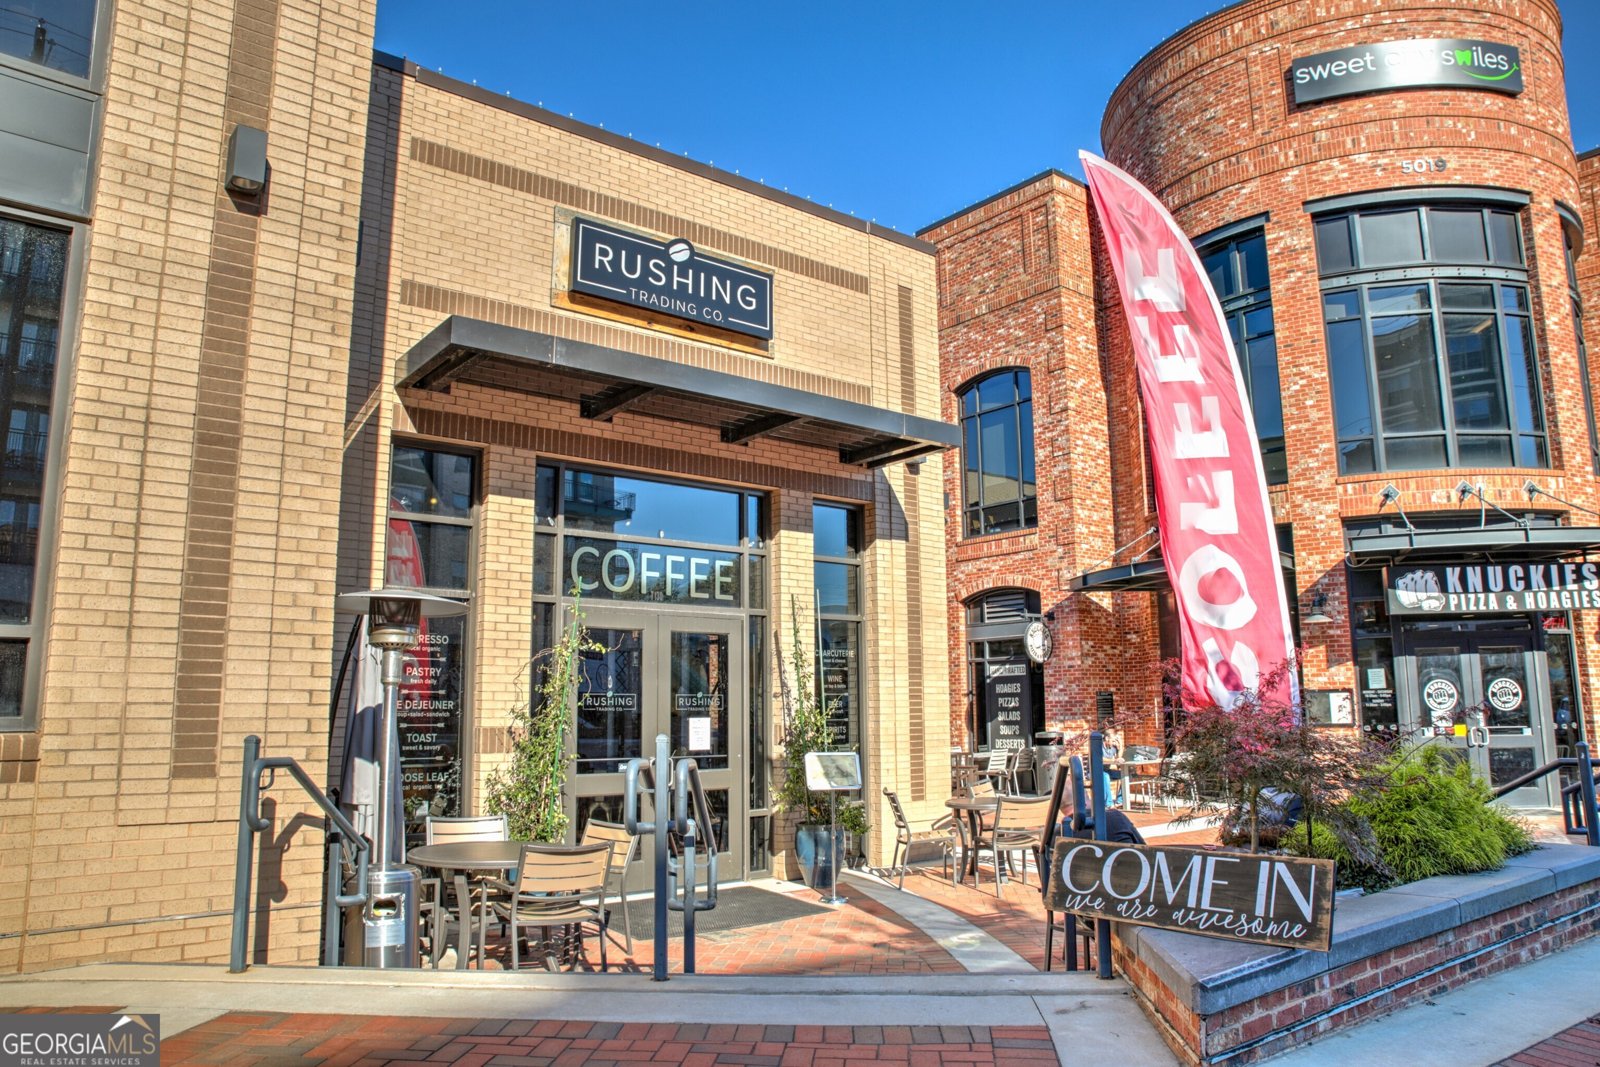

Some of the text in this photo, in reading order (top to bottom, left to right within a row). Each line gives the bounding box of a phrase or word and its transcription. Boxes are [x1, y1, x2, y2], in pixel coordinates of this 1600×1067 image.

[1296, 51, 1376, 84] sweet
[1401, 158, 1447, 174] 5019
[594, 243, 757, 311] RUSHING
[629, 287, 725, 323] TRADING CO.
[570, 546, 734, 601] COFFEE
[1448, 590, 1600, 611] PIZZA & HOAGIES
[418, 634, 449, 645] RESSO
[406, 666, 442, 677] PASTRY
[827, 675, 843, 683] WINE
[995, 683, 1021, 694] HOAGIES
[405, 700, 454, 710] DEJEUNER
[586, 697, 633, 706] RUSHING
[678, 697, 721, 706] RUSHING
[998, 697, 1020, 707] PIZZAS
[997, 710, 1021, 721] SALADS
[999, 725, 1020, 735] SOUPS
[406, 733, 438, 743] TOAST
[995, 739, 1026, 750] DESSERTS
[1061, 844, 1316, 924] COME IN
[1064, 893, 1308, 938] we are awesome
